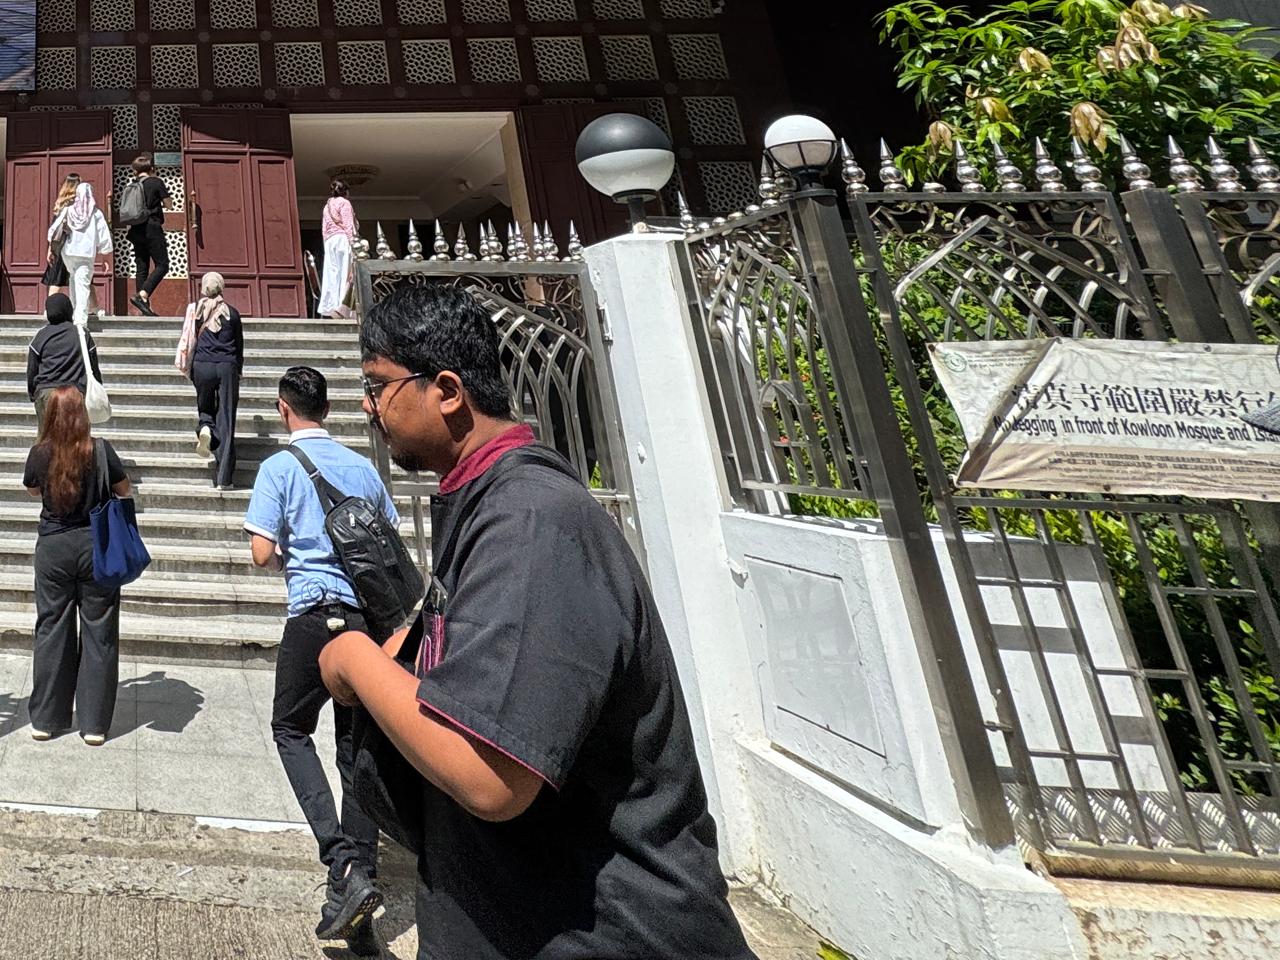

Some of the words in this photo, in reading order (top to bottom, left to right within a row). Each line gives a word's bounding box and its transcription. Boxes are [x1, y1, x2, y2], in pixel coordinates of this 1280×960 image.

[1059, 415, 1074, 434] in
[1074, 415, 1107, 435] front
[1107, 416, 1121, 436] of
[1121, 418, 1175, 438] Kowloon
[1174, 420, 1226, 444] Mosque
[1226, 423, 1252, 441] and
